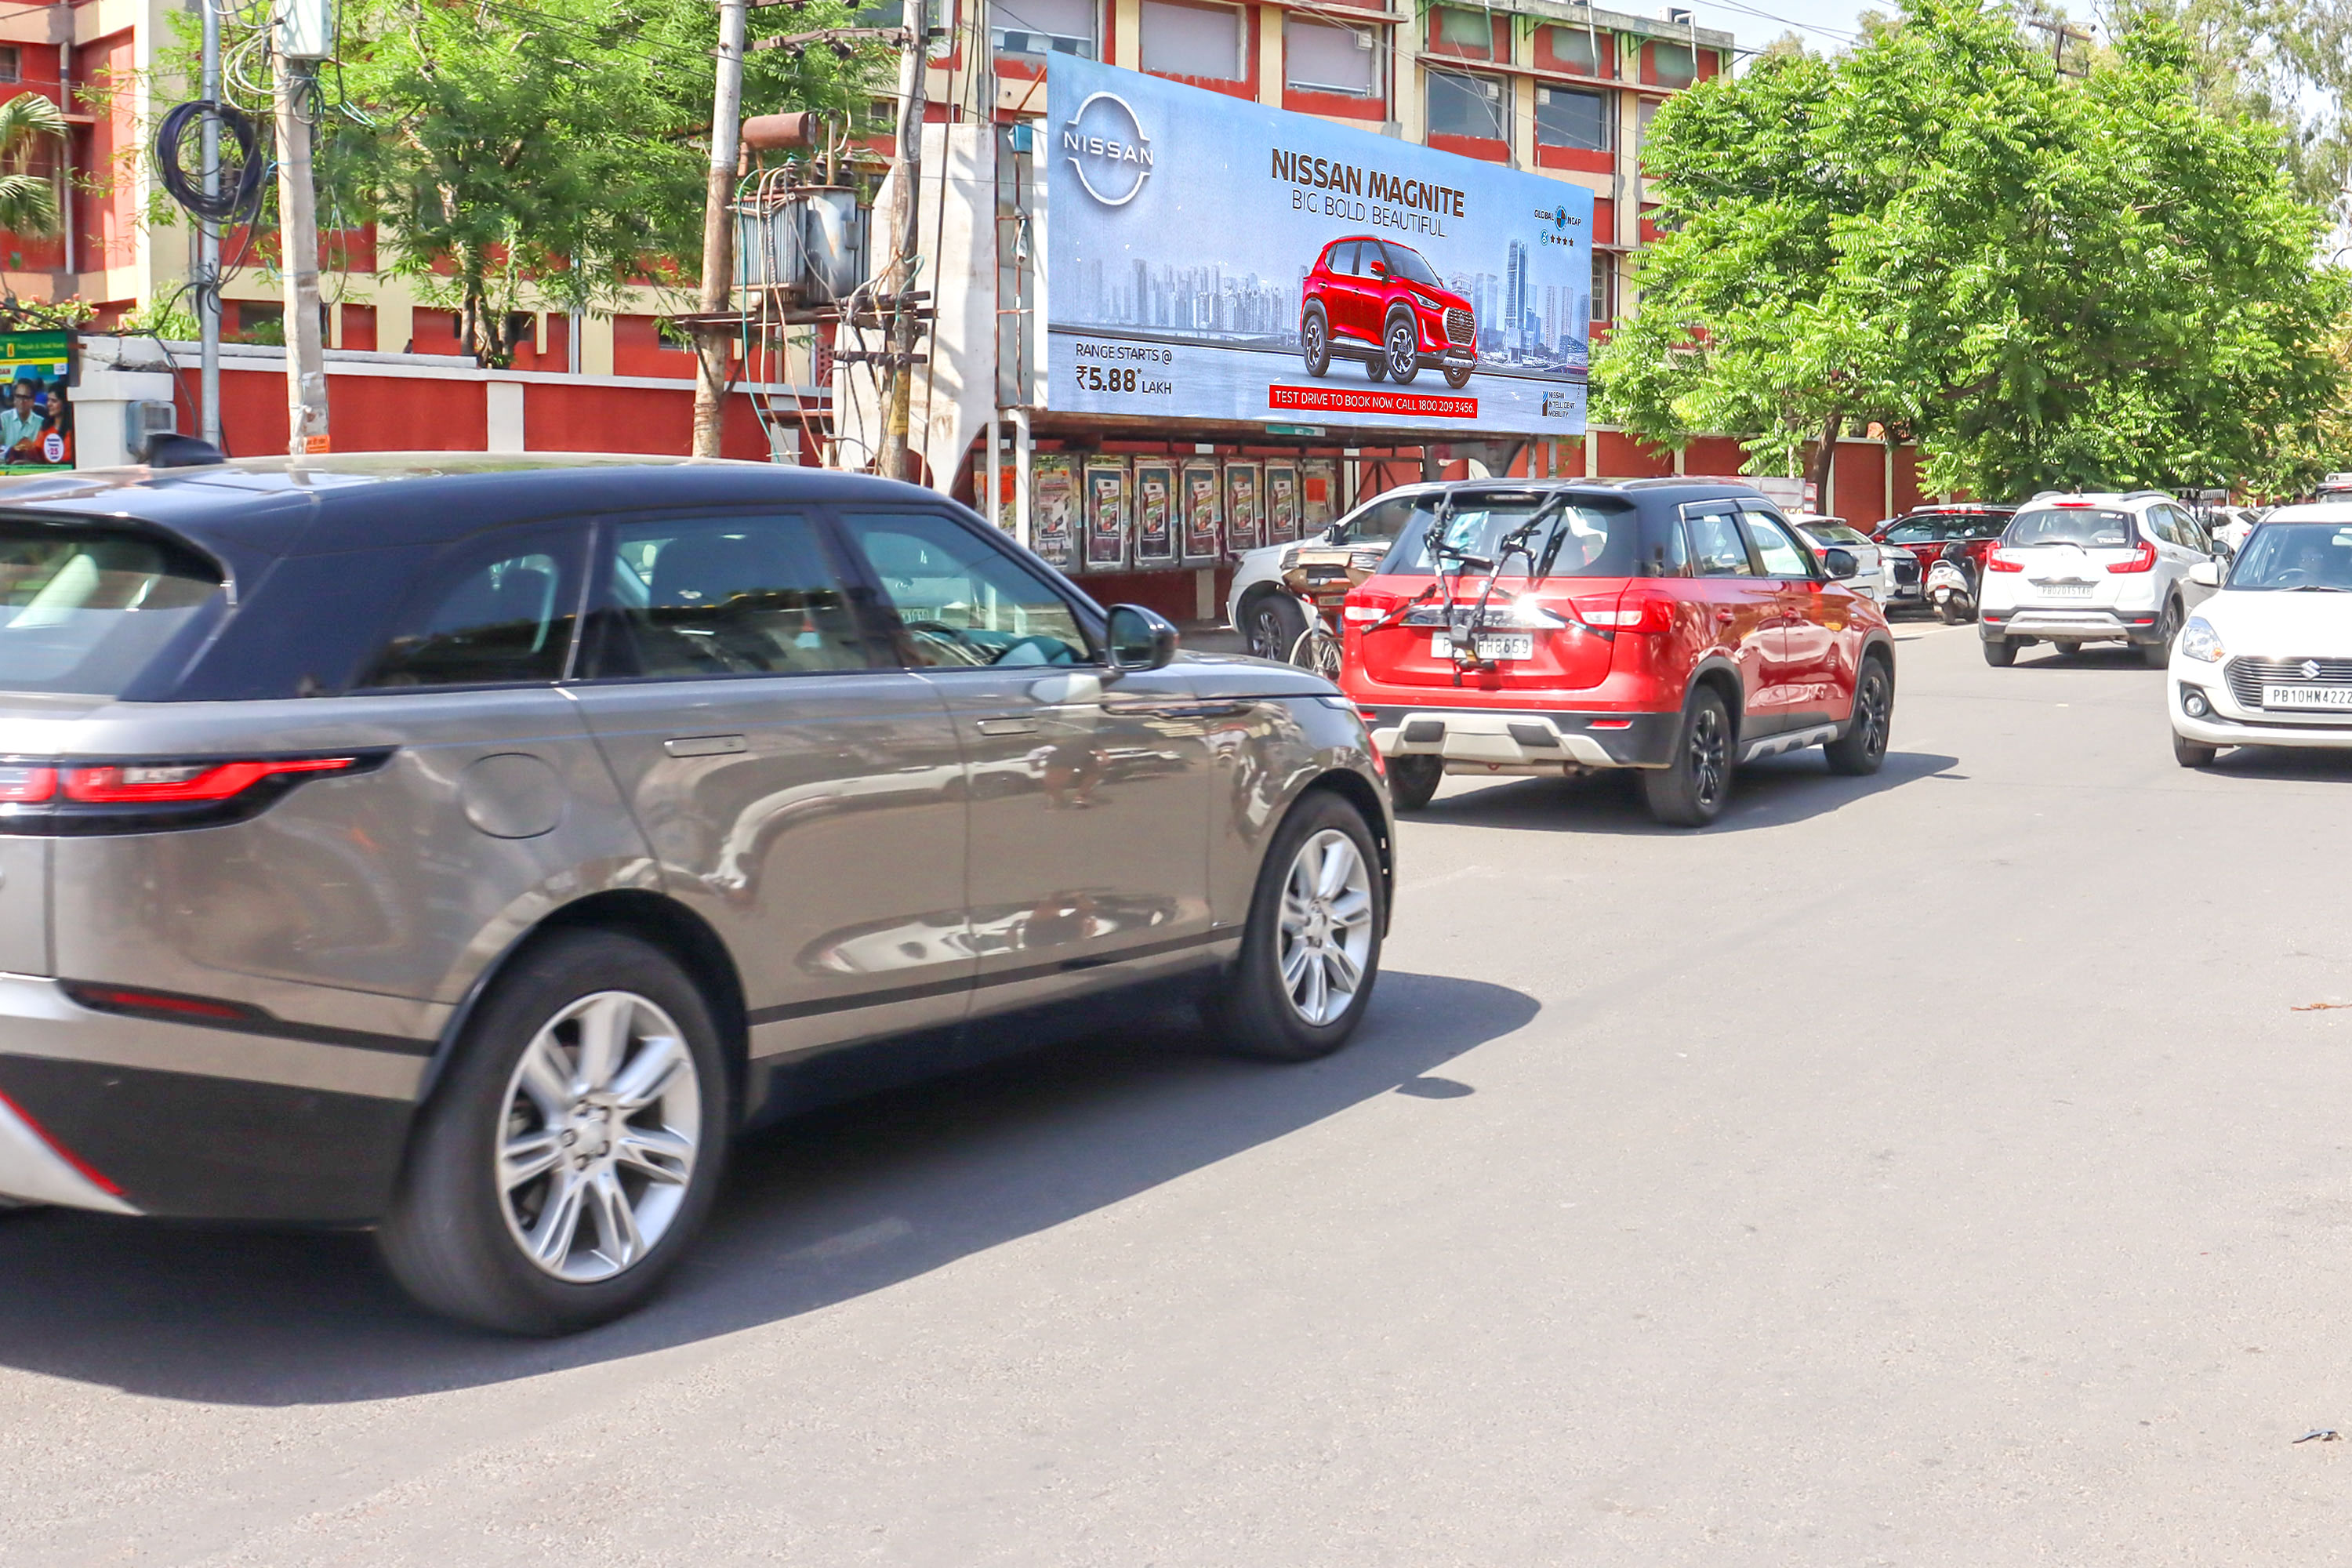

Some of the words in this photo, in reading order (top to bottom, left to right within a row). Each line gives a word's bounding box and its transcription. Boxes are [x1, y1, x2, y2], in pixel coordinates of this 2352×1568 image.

[1064, 131, 1153, 165] NISSAN
[1272, 148, 1362, 196] NISSAN
[1368, 171, 1465, 218] MAGNITE
[1292, 189, 1320, 213] BIG.
[1325, 196, 1368, 223] BOLD.
[1373, 205, 1447, 238] BEAUTIFUL.
[1534, 209, 1554, 221] GLOBAL
[1567, 216, 1581, 226] NCAP
[1076, 343, 1115, 358] RANGE
[1117, 347, 1159, 361] STARTS
[1161, 350, 1172, 365] @
[1142, 381, 1172, 394] LAKH
[1276, 390, 1299, 404] TEST
[1301, 392, 1328, 405] DRIVE
[1330, 394, 1343, 406] TO
[1345, 394, 1370, 407] BOOK
[1373, 396, 1394, 408] NOW.
[1396, 397, 1417, 410] CALL
[1418, 400, 1437, 412] 1800
[1439, 401, 1454, 412] 209
[1455, 401, 1475, 413] 3456.
[2273, 689, 2352, 704] PB10HN4222
